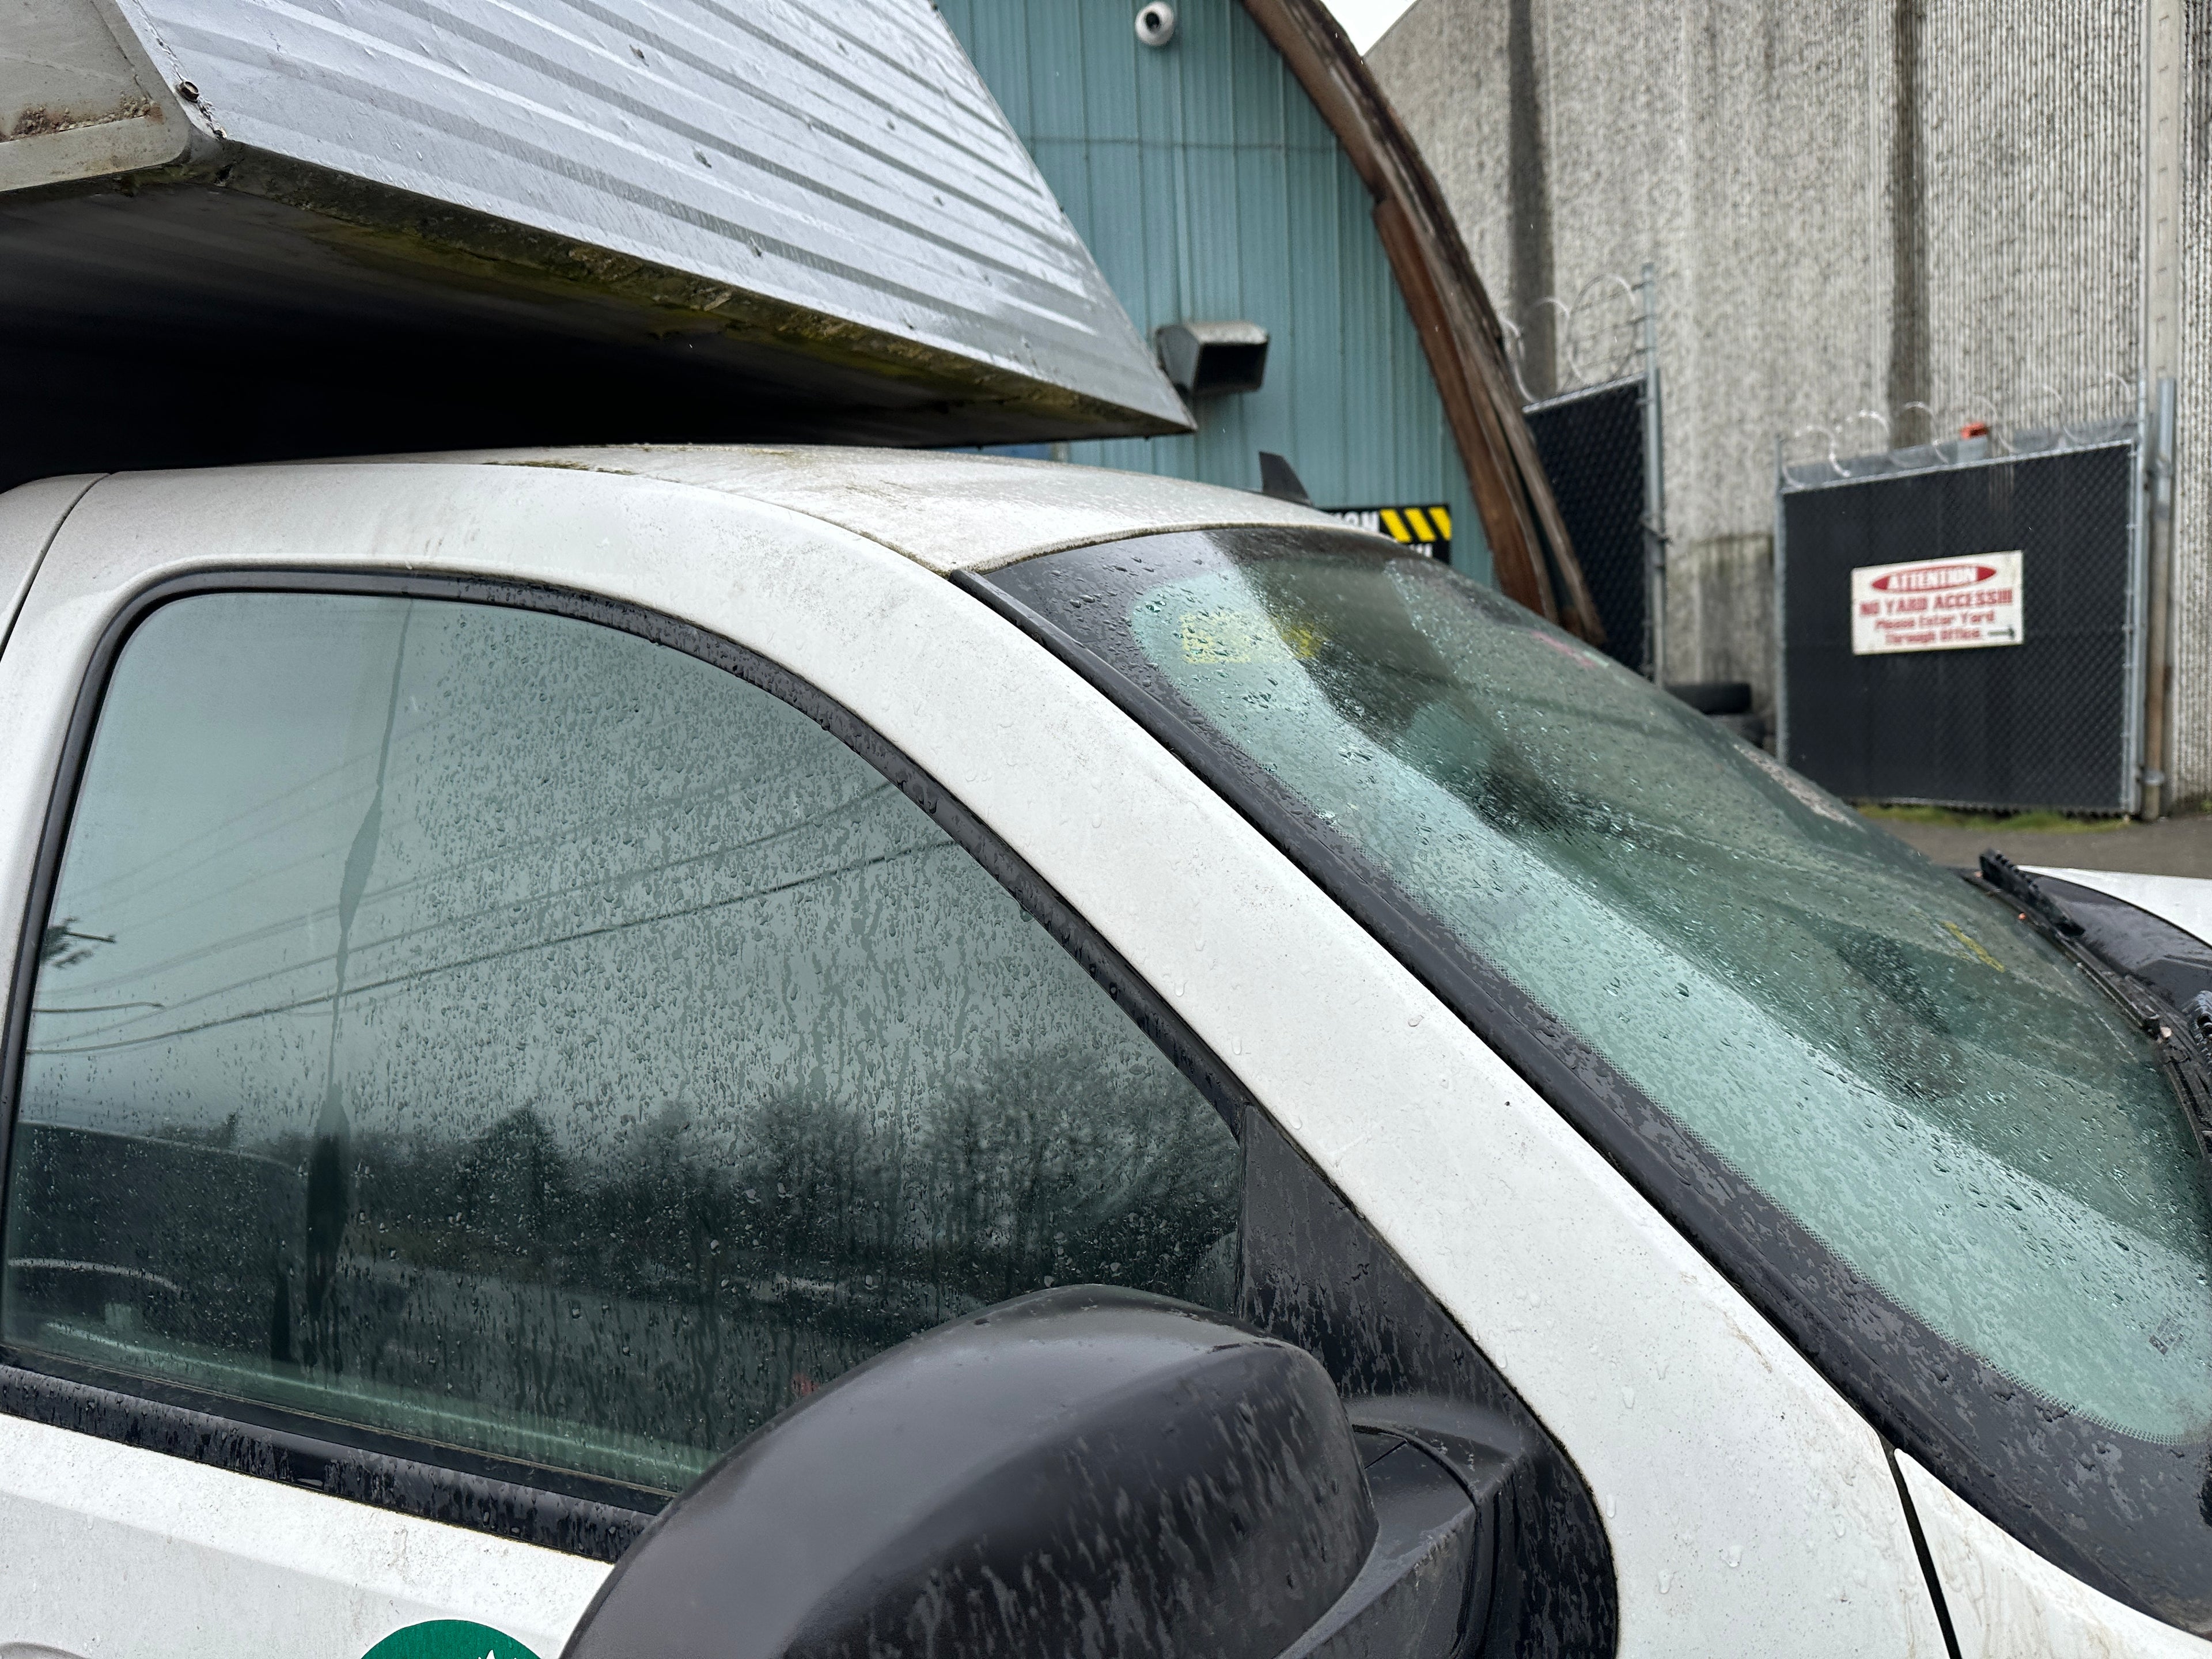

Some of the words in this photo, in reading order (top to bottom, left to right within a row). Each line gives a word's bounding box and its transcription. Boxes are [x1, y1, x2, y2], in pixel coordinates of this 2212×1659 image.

[1887, 567, 1976, 590] ATTENTION
[1860, 601, 1880, 615] NO
[1885, 597, 1928, 613] YARD
[1919, 615, 1955, 627] Enter
[1961, 611, 1994, 623] Yard
